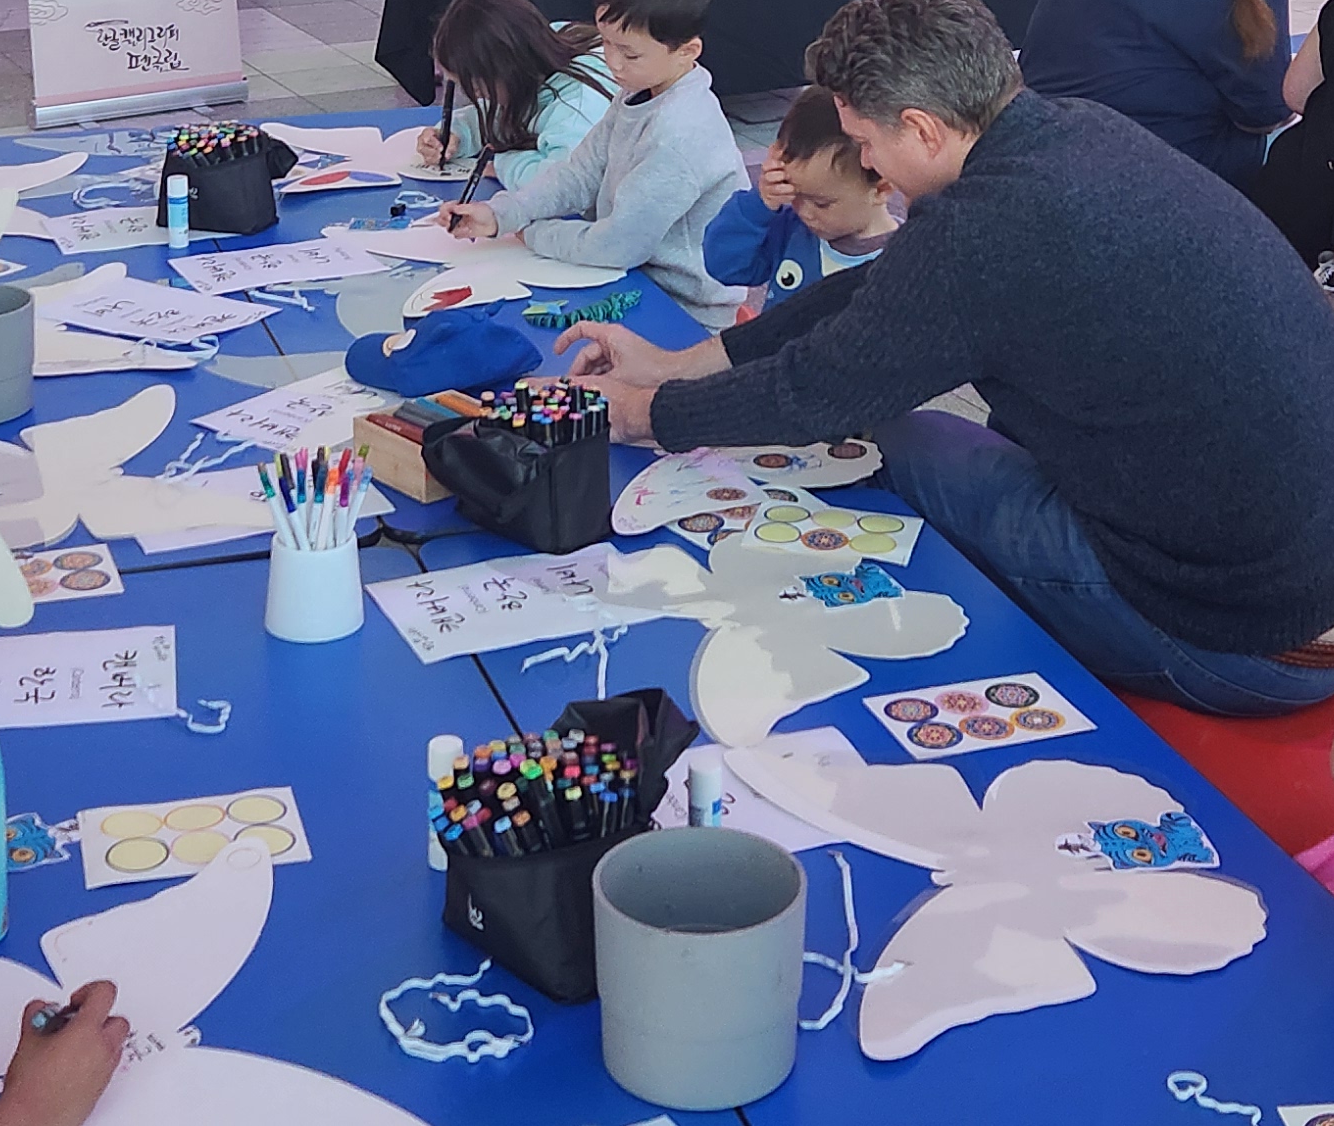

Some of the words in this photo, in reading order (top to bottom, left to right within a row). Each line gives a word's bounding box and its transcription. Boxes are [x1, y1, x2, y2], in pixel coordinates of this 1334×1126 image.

[406, 579, 466, 634] 캔버라
[14, 665, 57, 706] 한국
[102, 648, 139, 709] 캔버라
